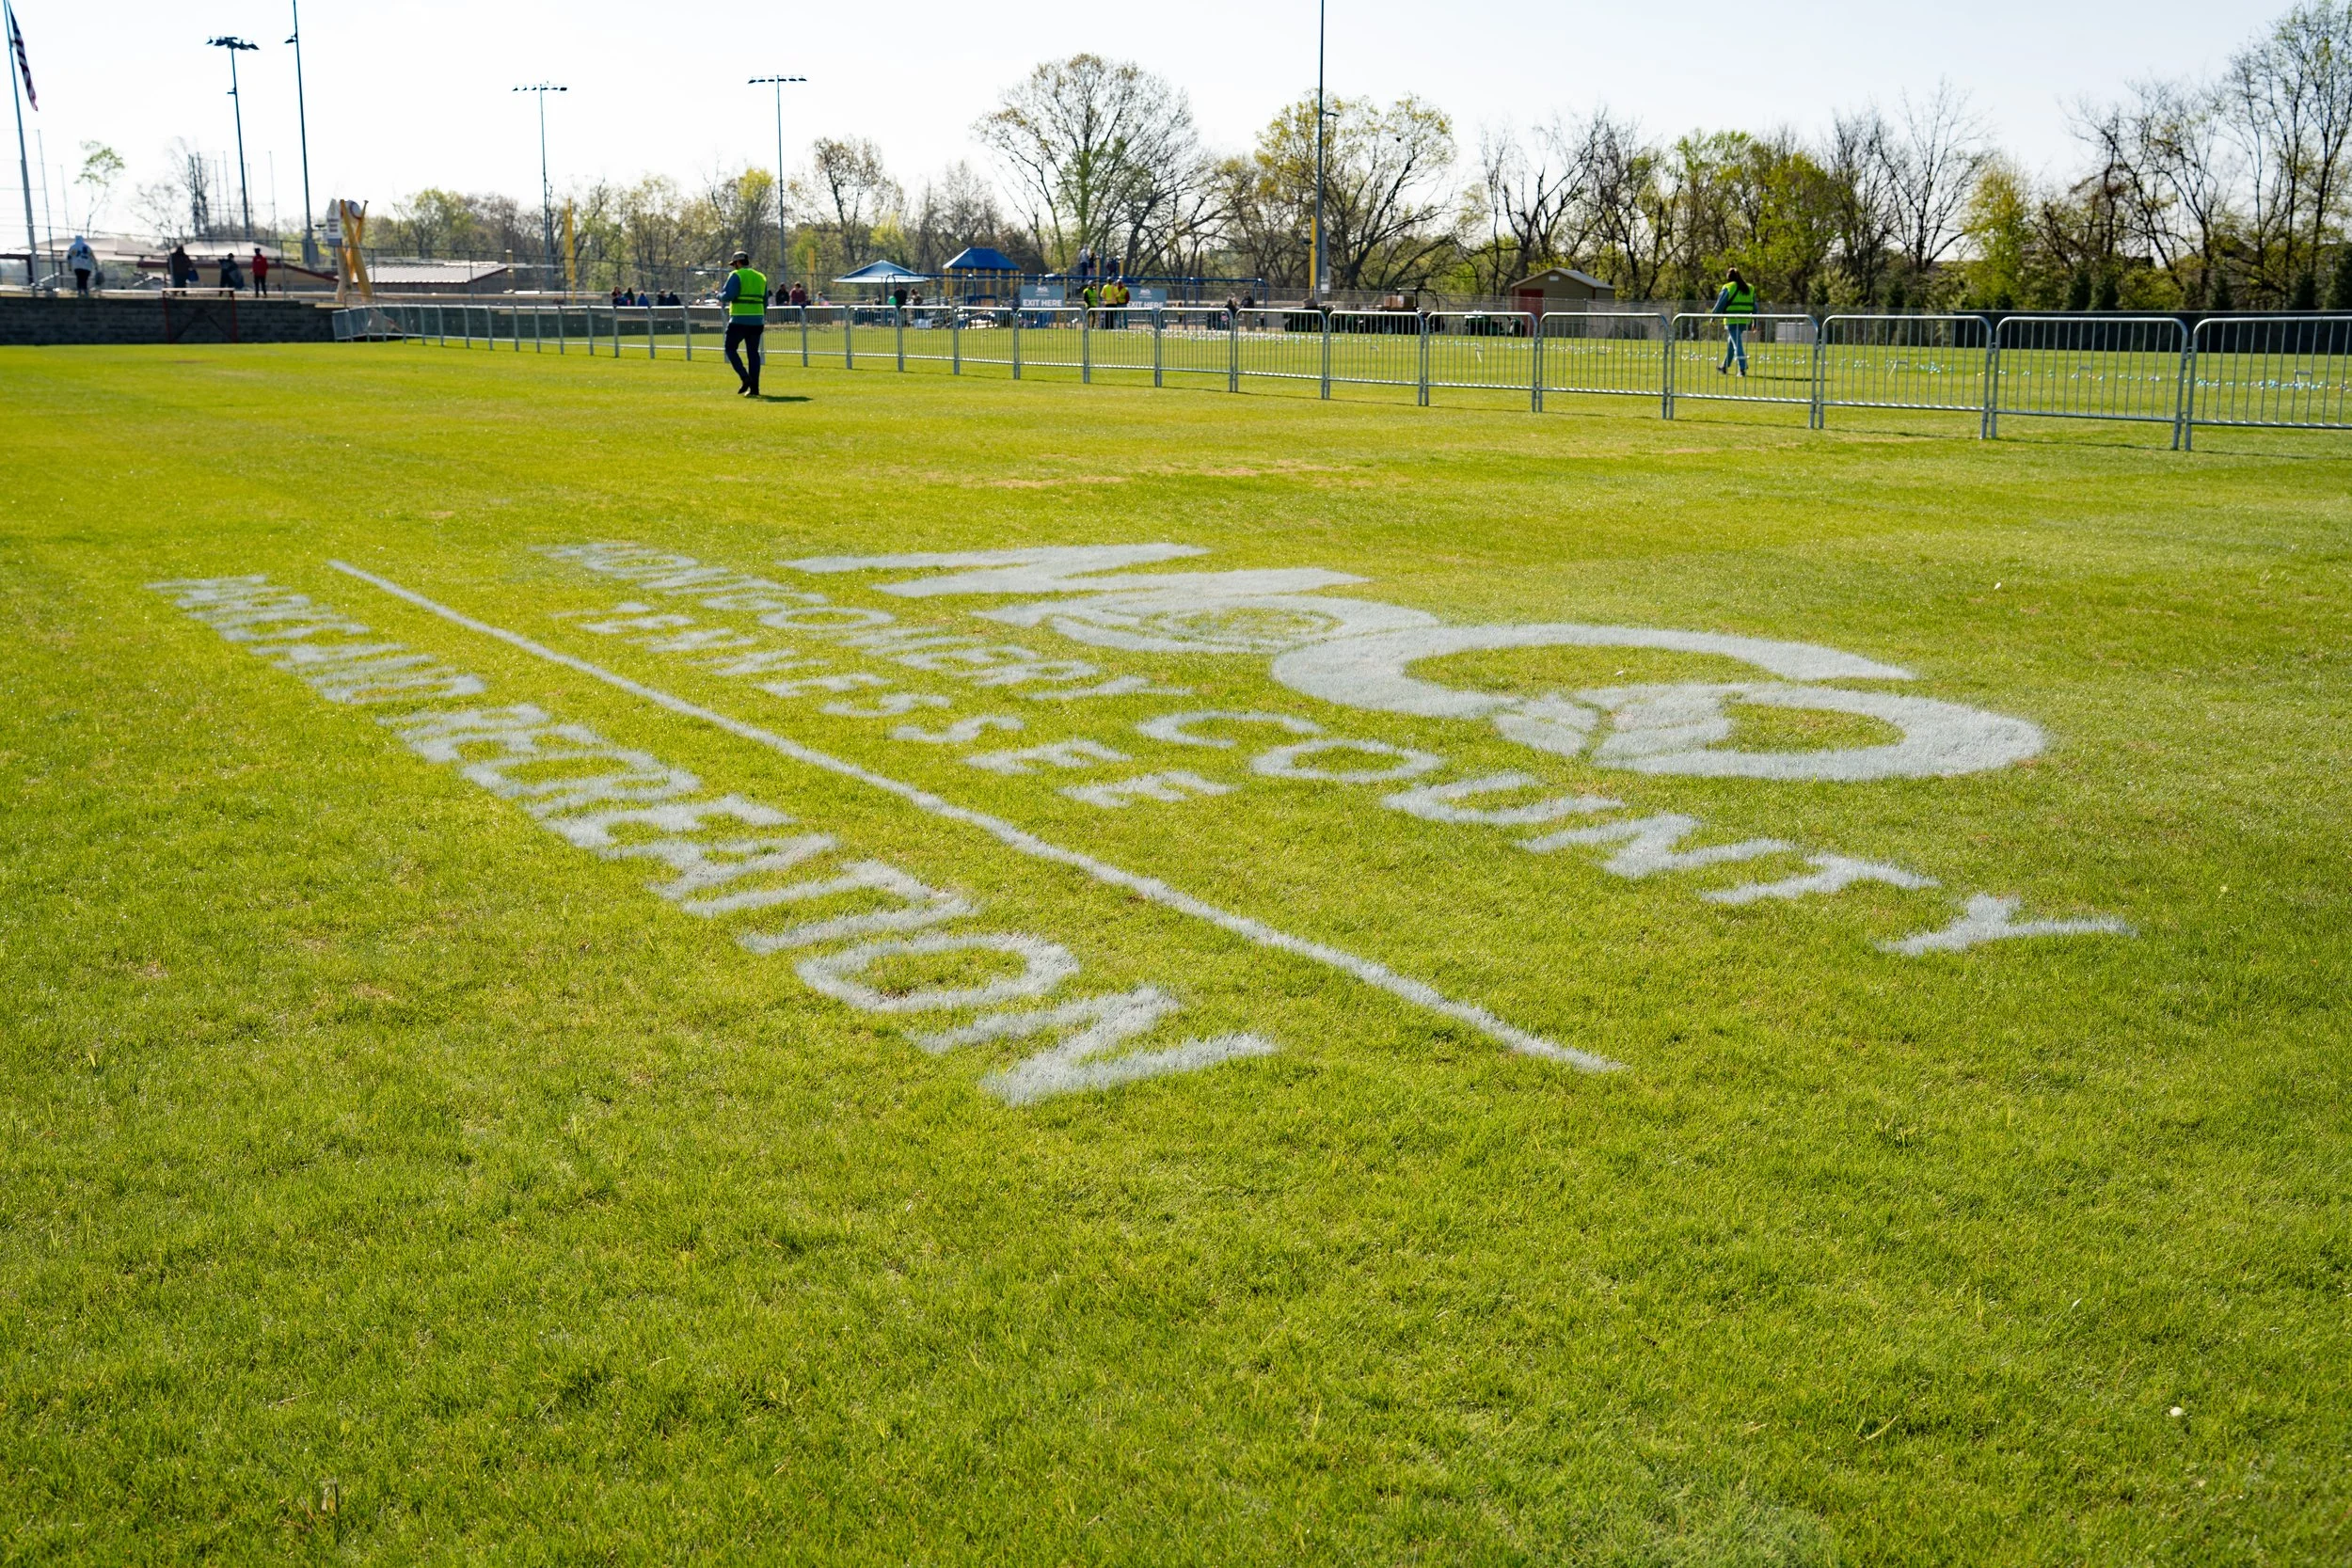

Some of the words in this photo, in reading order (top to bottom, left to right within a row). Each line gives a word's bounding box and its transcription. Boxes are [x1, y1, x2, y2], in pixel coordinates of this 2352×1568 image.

[1022, 298, 1040, 307] EXIT
[1041, 299, 1063, 308] HERE
[148, 575, 369, 641] PARKS
[250, 642, 485, 705] AND
[529, 542, 1193, 700] MONTGOMERY
[1134, 710, 2137, 958] COUNTY
[552, 601, 1238, 809] TENNESSEE
[377, 703, 1278, 1108] RECREATION
